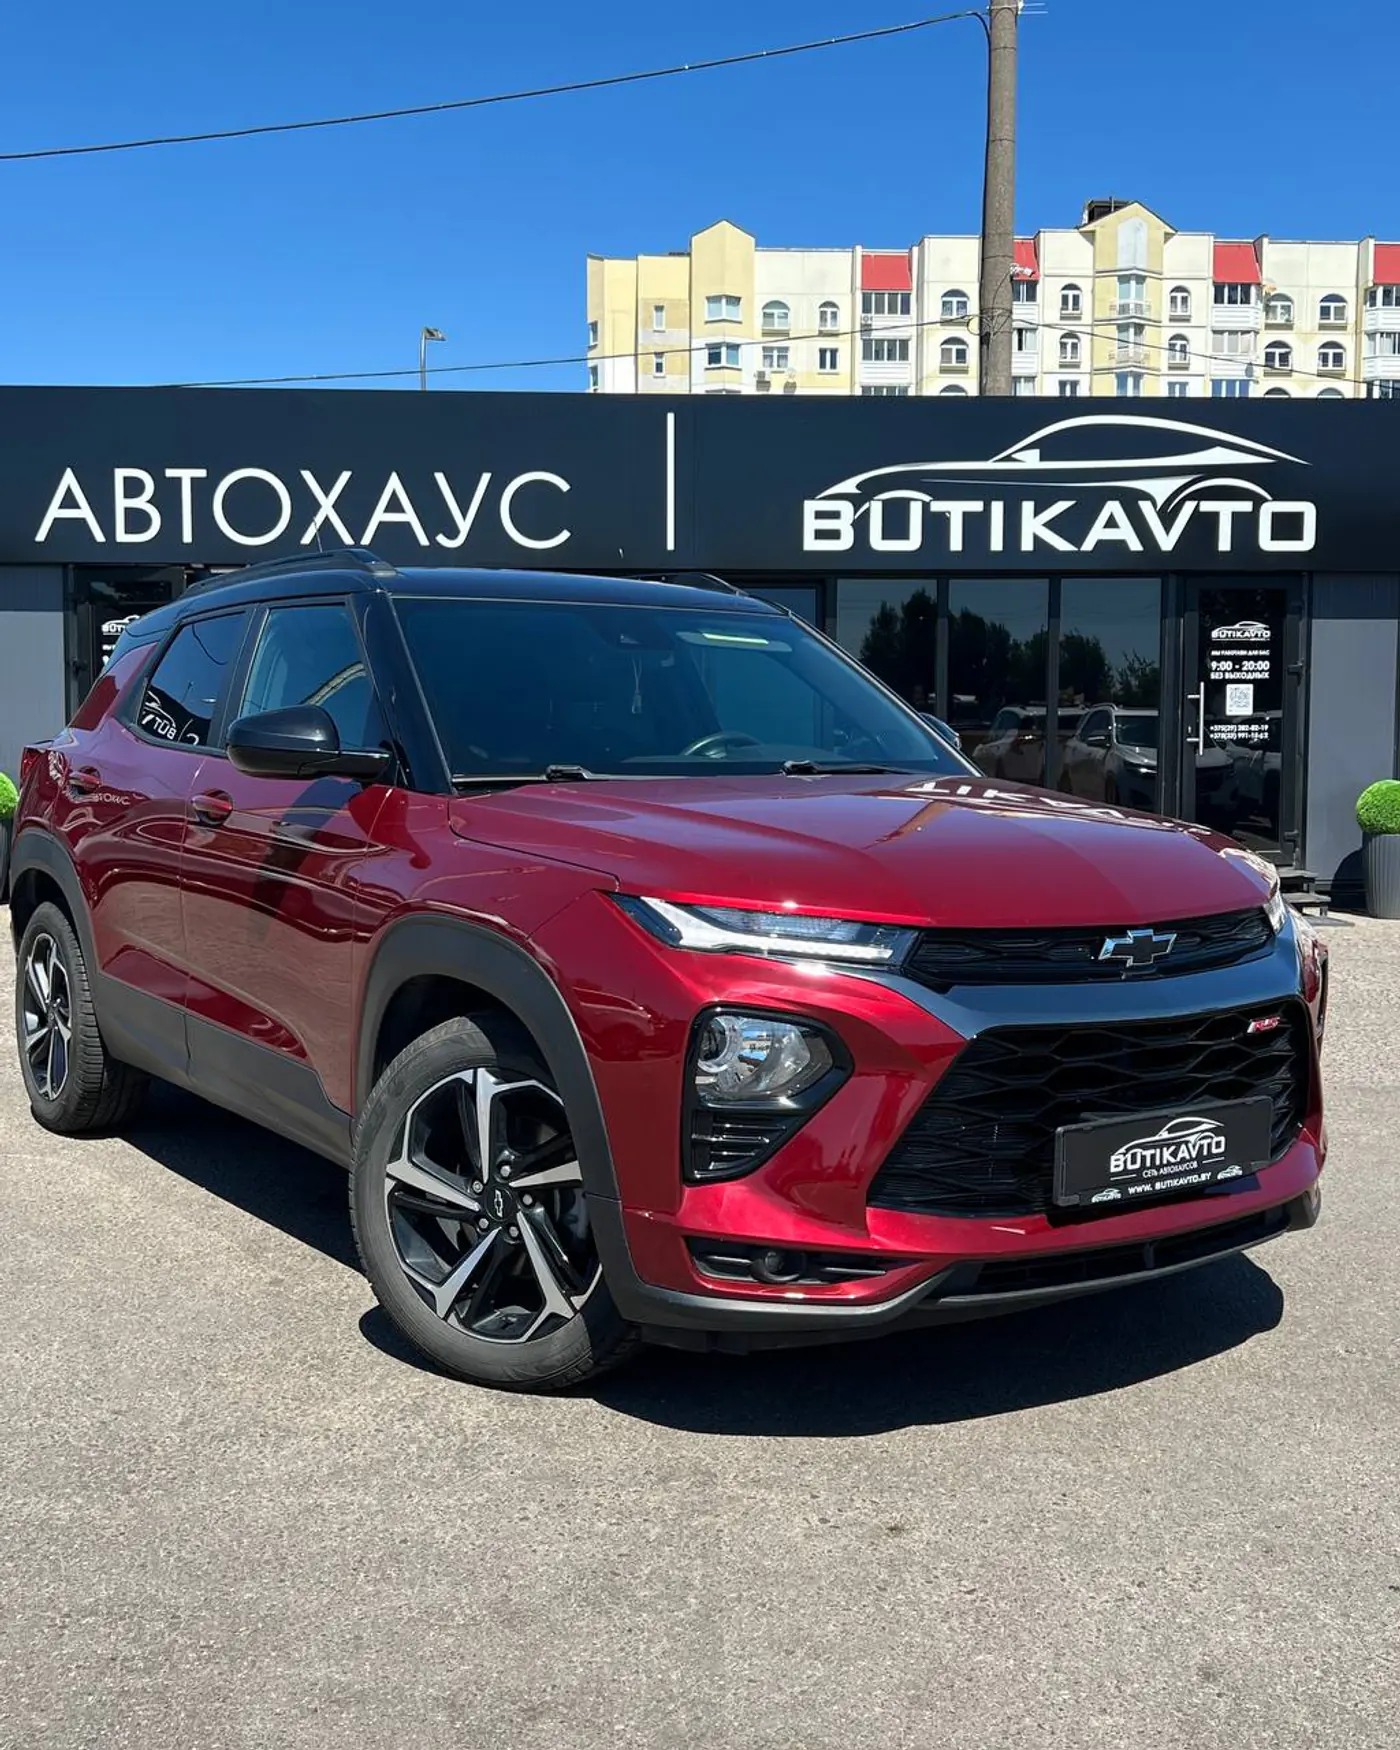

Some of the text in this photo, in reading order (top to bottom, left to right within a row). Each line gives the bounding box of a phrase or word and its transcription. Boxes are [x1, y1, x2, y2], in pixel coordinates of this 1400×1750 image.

[35, 467, 572, 549] АВТОХАУС
[803, 500, 1317, 552] BUTIKAVTO
[1211, 630, 1271, 638] BUTIKAVTO
[1211, 661, 1233, 671] 9:00
[1241, 661, 1270, 671] 20:00
[1110, 1136, 1225, 1173] BUTIKAVTO
[1128, 1183, 1153, 1195] WWW.
[1155, 1172, 1212, 1190] BUTIKAVTO.BY
